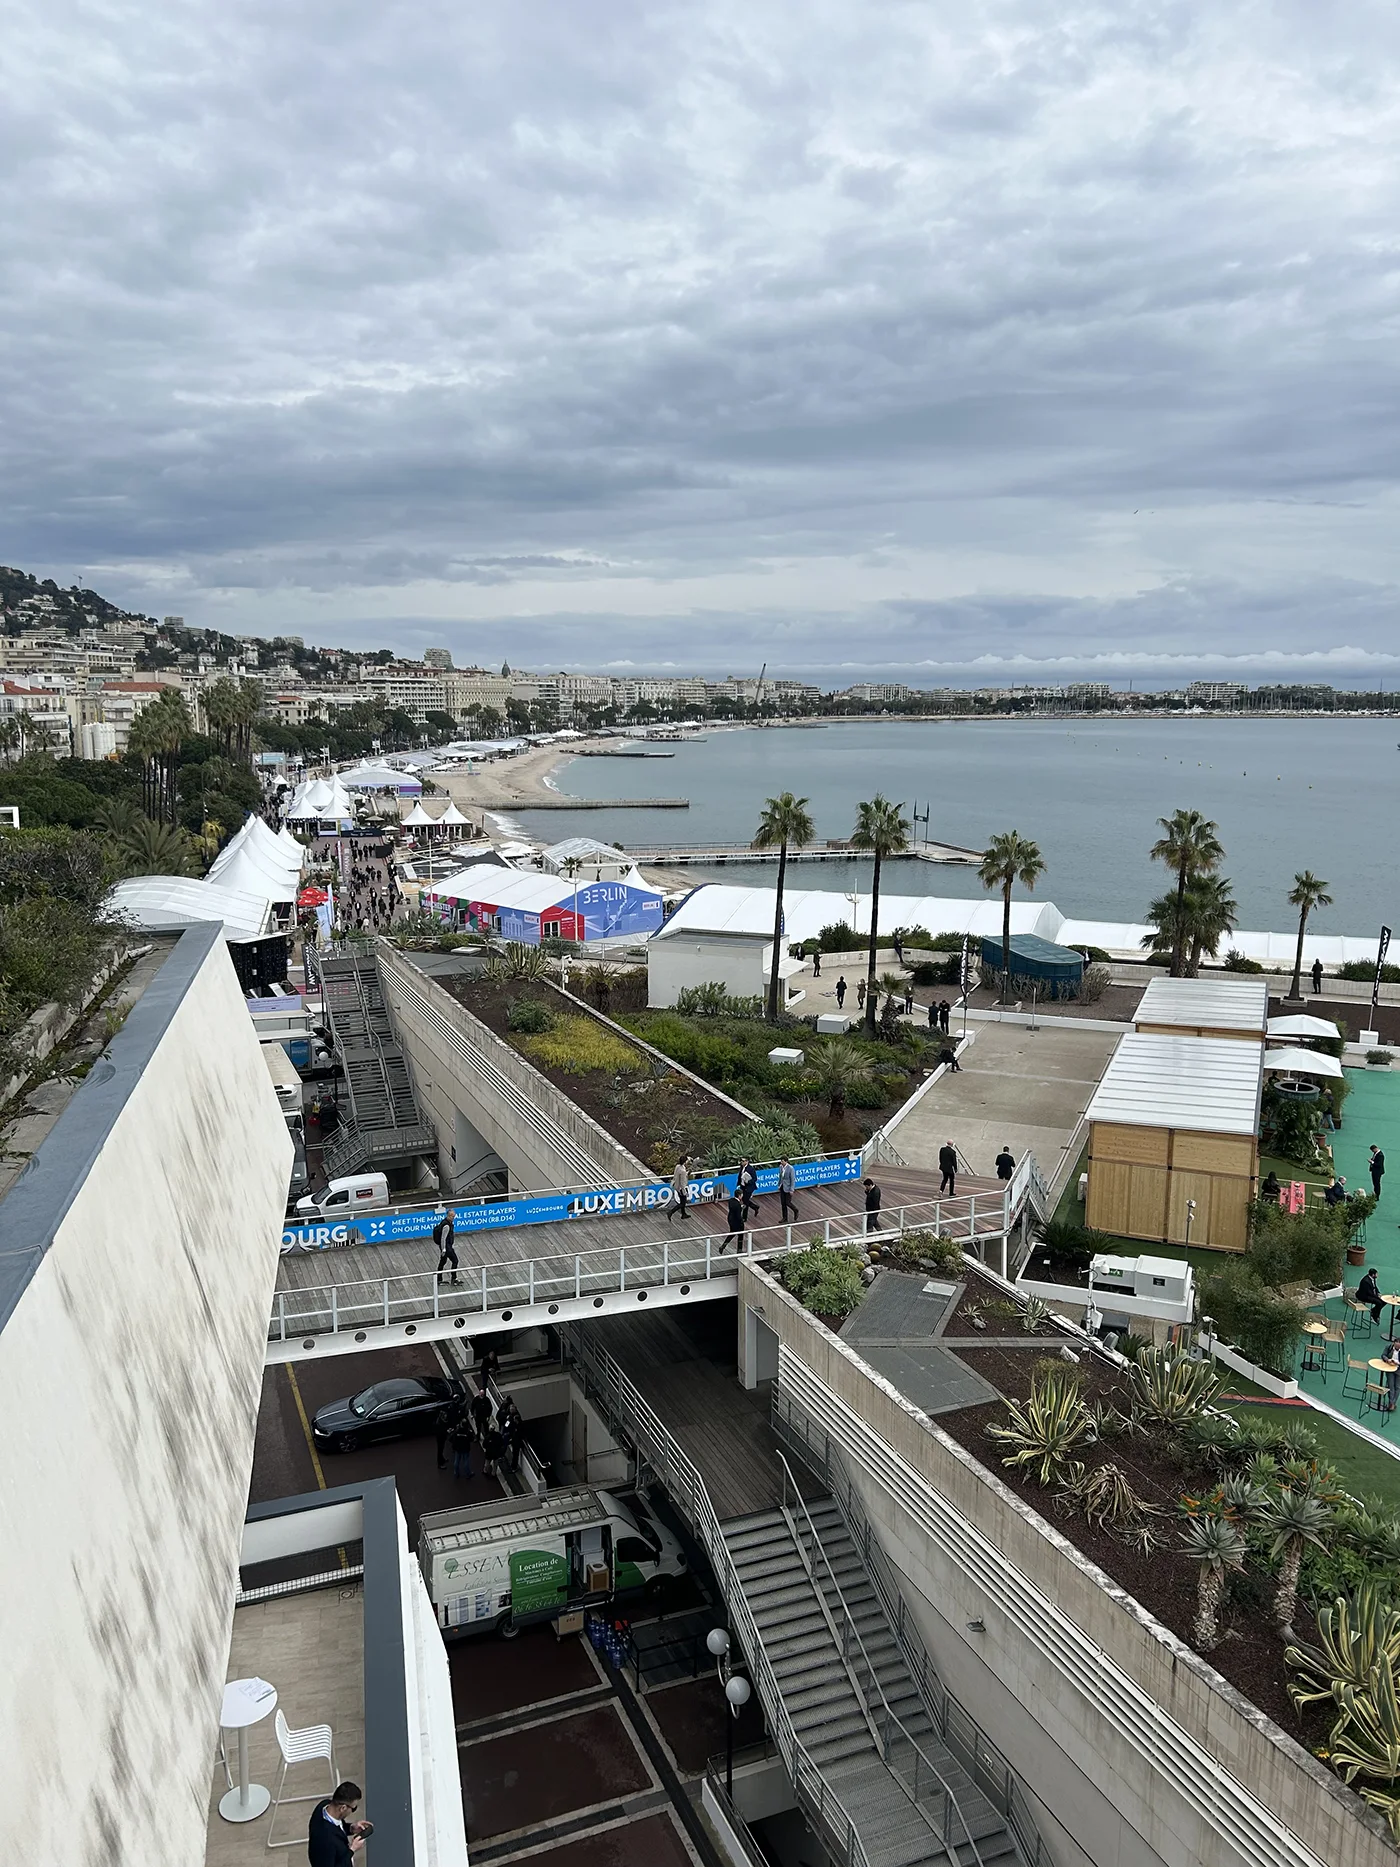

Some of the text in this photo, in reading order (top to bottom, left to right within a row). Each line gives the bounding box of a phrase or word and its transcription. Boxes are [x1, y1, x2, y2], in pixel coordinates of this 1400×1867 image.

[583, 887, 627, 904] BERLIN
[796, 1167, 815, 1175] ESTATE
[816, 1164, 840, 1172] PLAYERS
[760, 1180, 778, 1188] NATIO
[391, 1217, 411, 1226] MEET
[412, 1216, 425, 1224] THE
[464, 1210, 487, 1218] ESTATE
[488, 1206, 516, 1215] PLAYERS
[404, 1225, 420, 1233] OUR
[457, 1218, 487, 1227] PAVILION
[519, 1561, 549, 1572] Location
